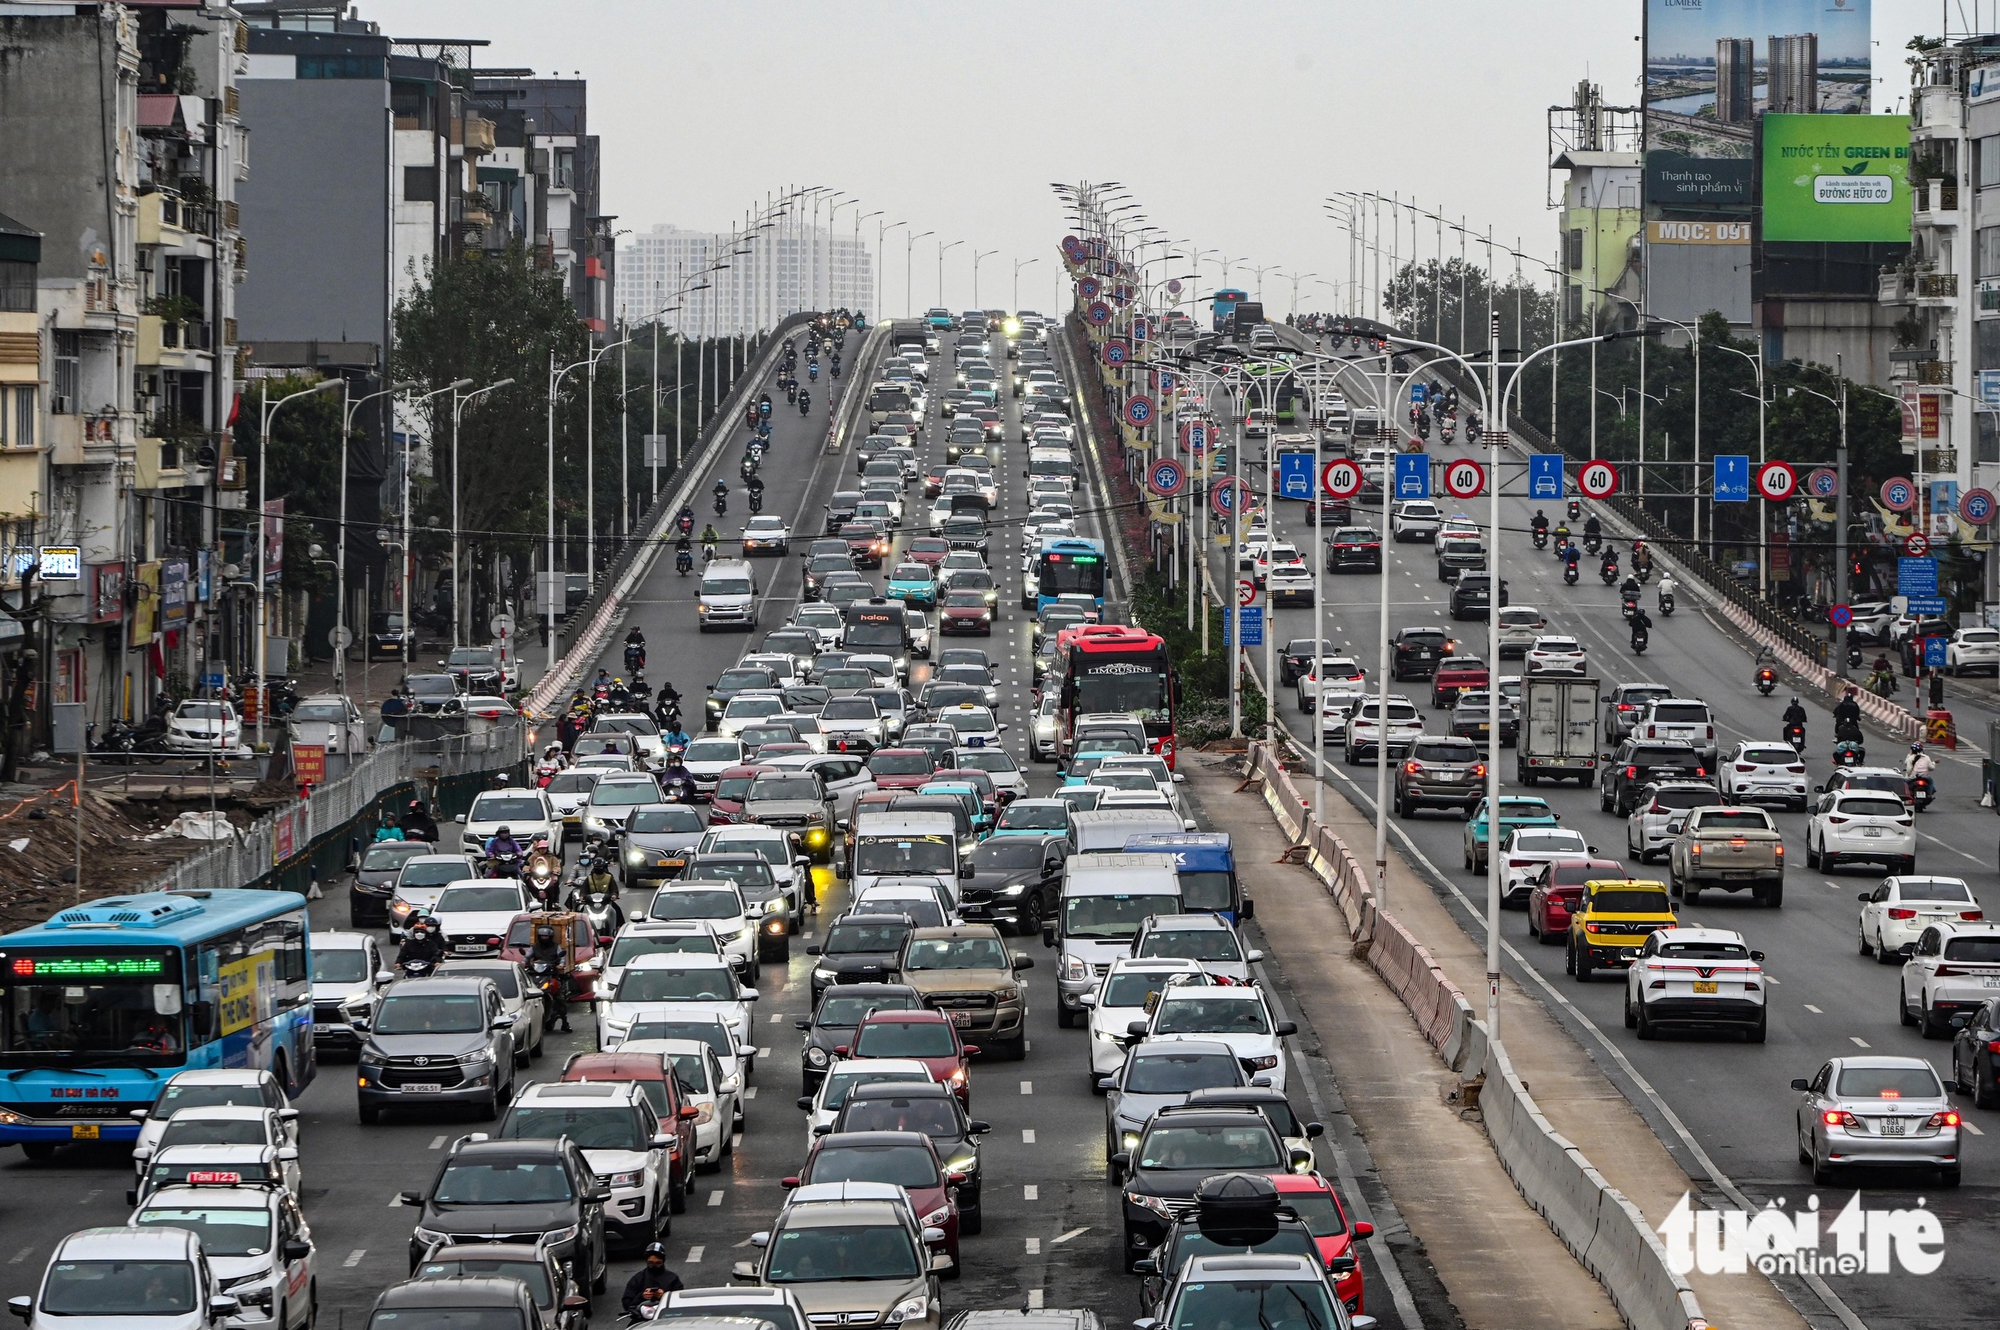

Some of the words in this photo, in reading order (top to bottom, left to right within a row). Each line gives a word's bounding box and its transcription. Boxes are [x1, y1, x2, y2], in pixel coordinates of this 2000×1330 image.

[1781, 144, 1814, 158] NƯỚC
[1817, 142, 1840, 158] YẾN
[1843, 146, 1890, 159] GREEN
[1895, 146, 1911, 158] BI
[1660, 171, 1692, 181] Thanh
[1676, 182, 1698, 192] sinh
[1819, 187, 1851, 199] ĐƯỜNG
[1875, 187, 1888, 199] CƠ
[1658, 223, 1710, 241] MQC:
[1334, 470, 1350, 487] 60
[1457, 470, 1473, 488] 60
[1590, 471, 1606, 489] 60
[1768, 472, 1785, 490] 40
[1087, 666, 1153, 676] LIMOUSINE
[297, 762, 305, 770] XE
[50, 1088, 64, 1098] XN
[65, 1087, 83, 1098] BUS
[1886, 1117, 1900, 1126] 89A
[1881, 1126, 1905, 1134] 016.56
[193, 1172, 213, 1182] Taxi
[215, 1172, 237, 1182] 123
